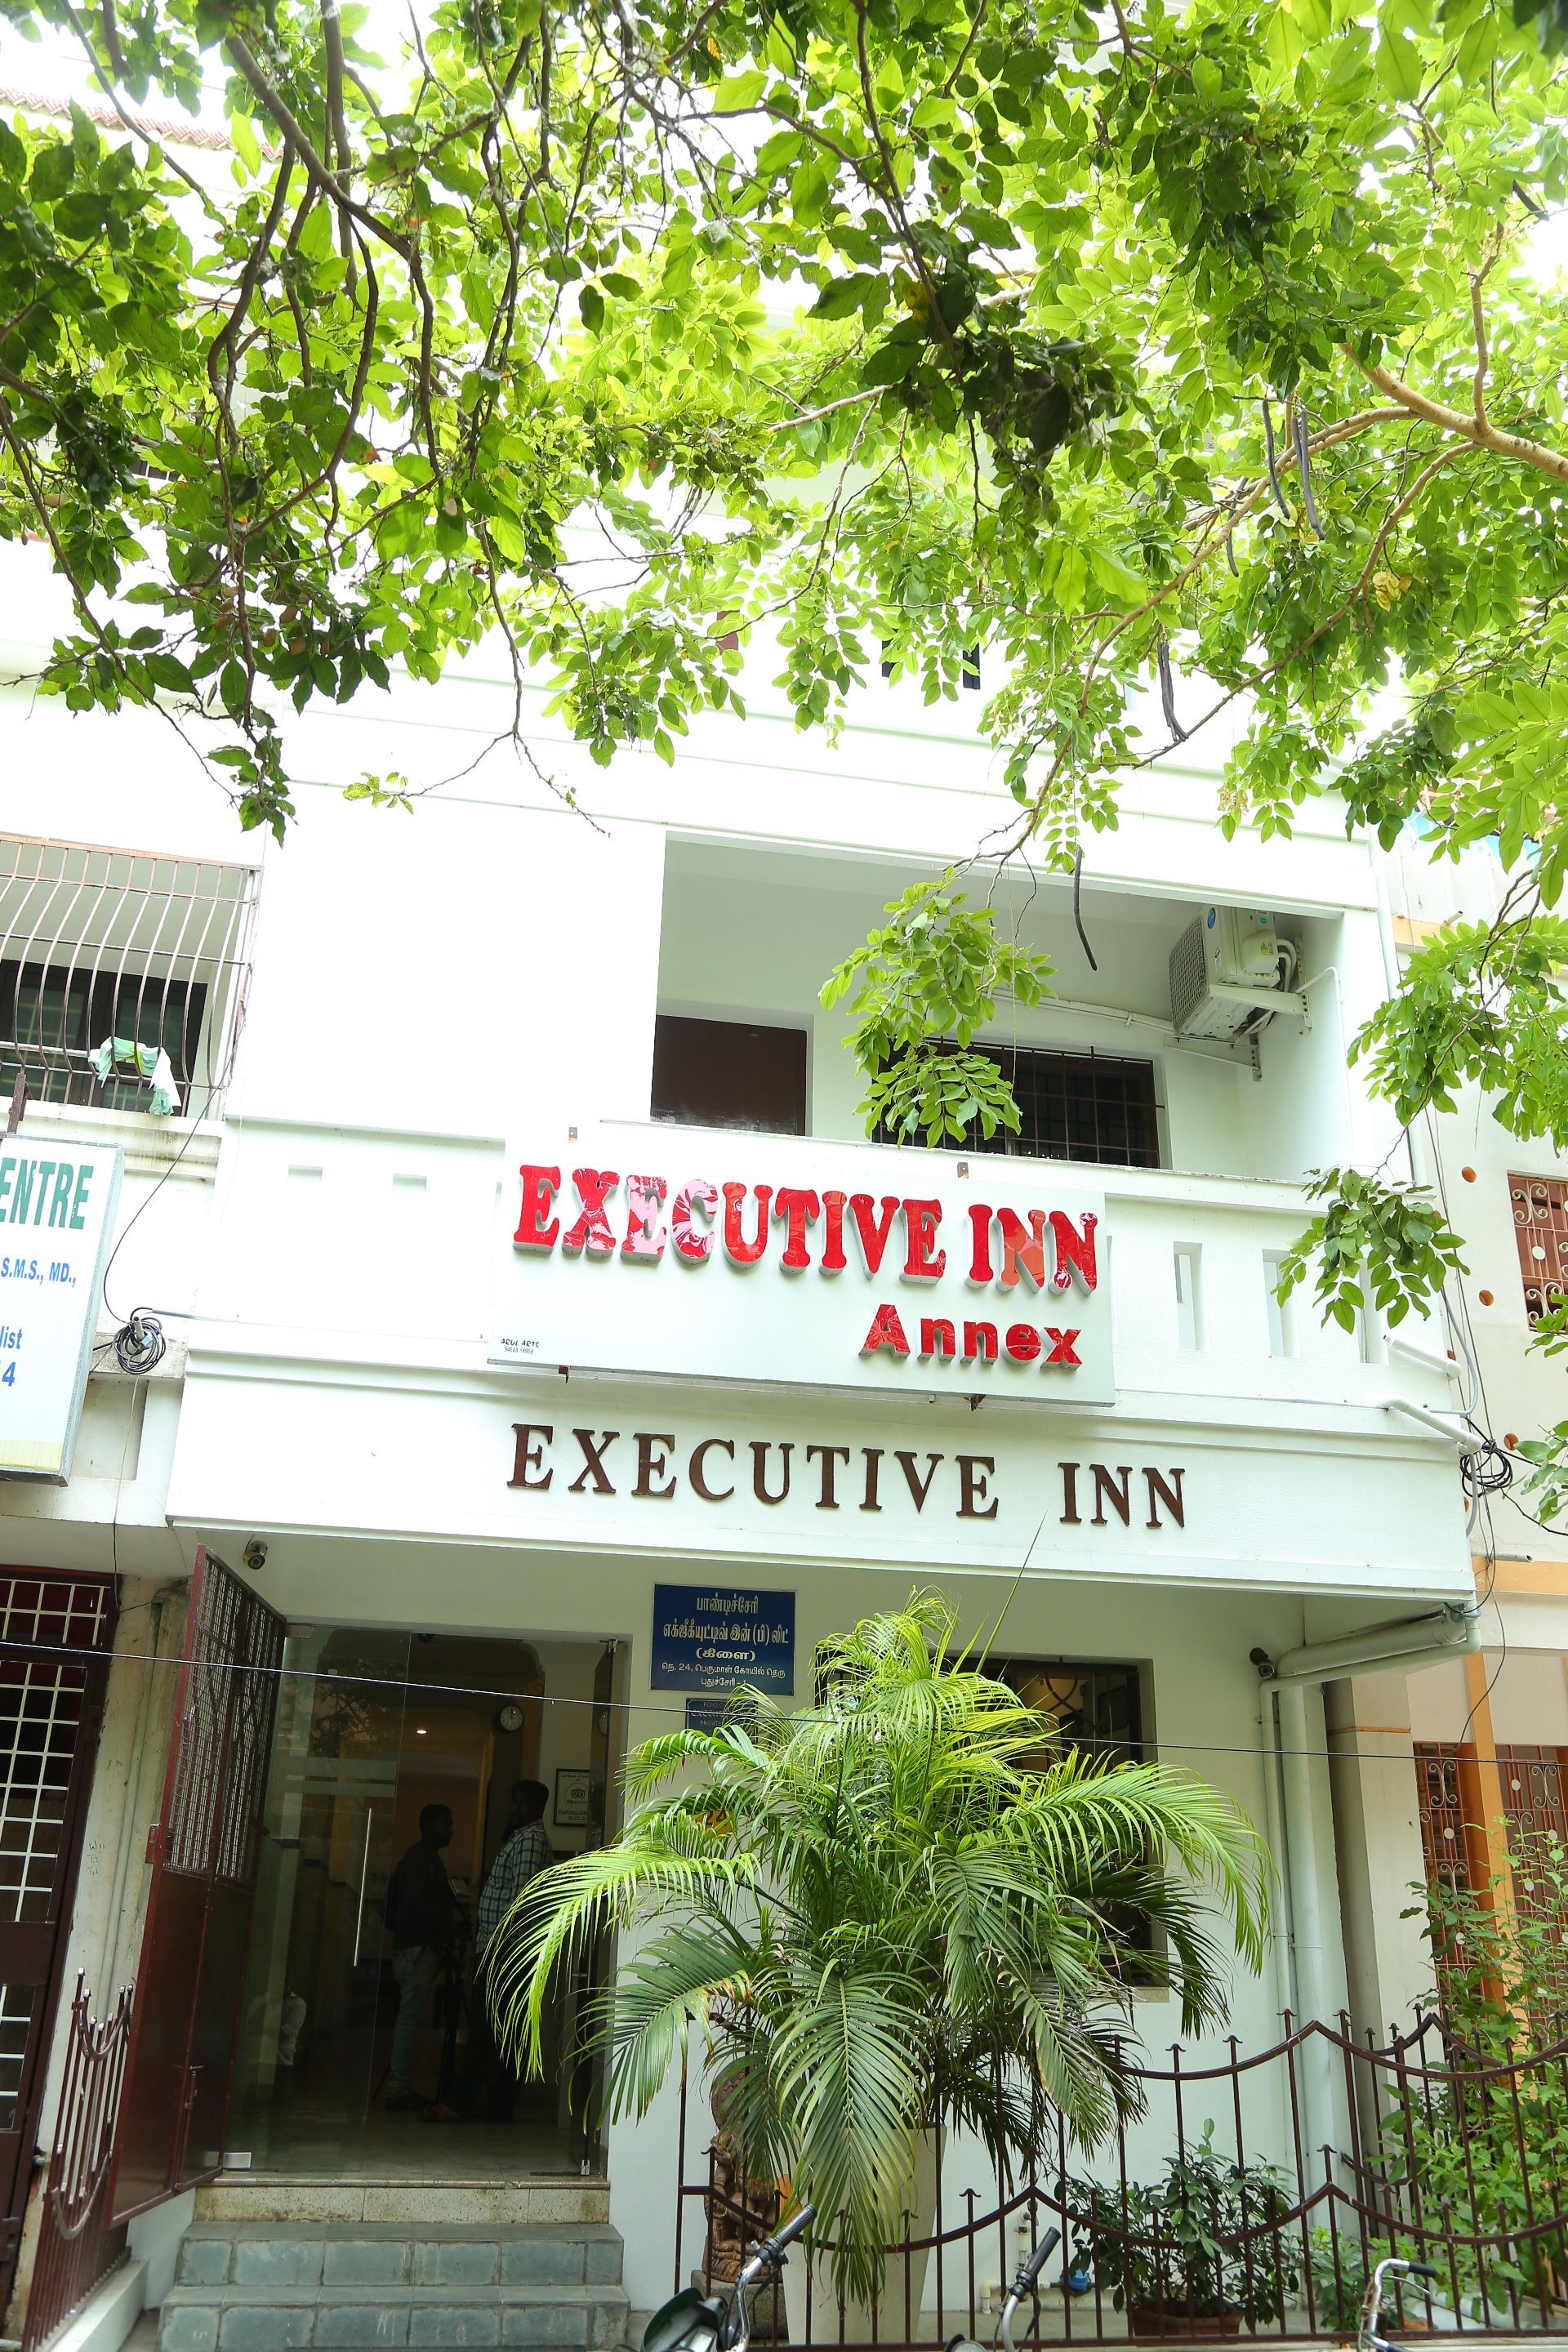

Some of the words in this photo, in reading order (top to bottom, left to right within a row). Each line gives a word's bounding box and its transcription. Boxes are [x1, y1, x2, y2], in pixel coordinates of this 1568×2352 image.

[512, 1164, 947, 1283] EXECUTIVE
[968, 1203, 1098, 1295] INN
[49, 1262, 76, 1287] MD.,
[501, 1338, 519, 1346] ARUL
[522, 1339, 540, 1348] ARTS
[858, 1303, 1082, 1370] Annex
[507, 1423, 1000, 1518] EXECUTIVE
[1058, 1462, 1187, 1529] INN
[697, 1592, 759, 1615] பாண்டிச்சேரி
[730, 1621, 751, 1642] இன்
[696, 1647, 756, 1662] (கிளை)
